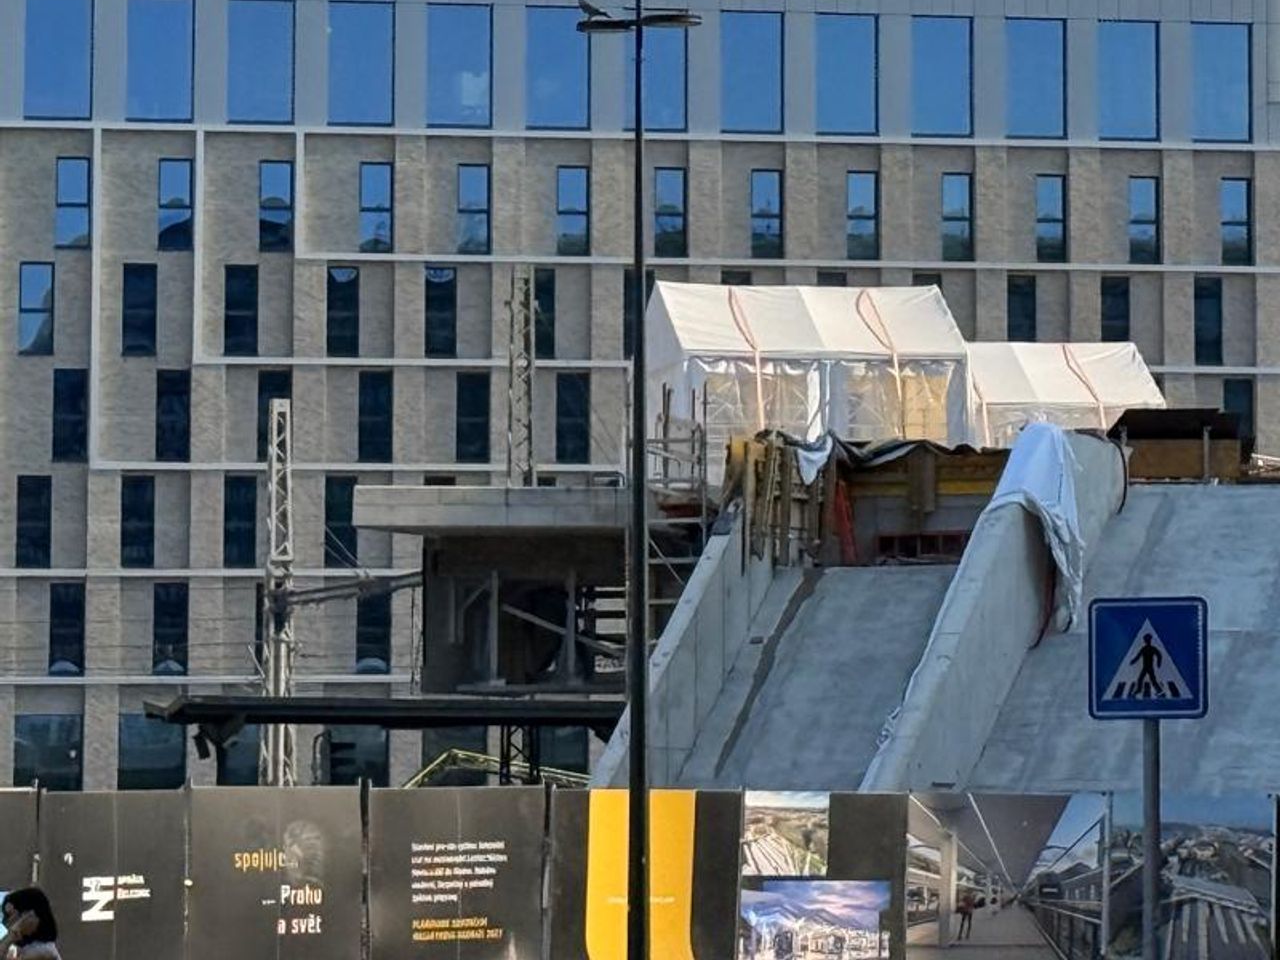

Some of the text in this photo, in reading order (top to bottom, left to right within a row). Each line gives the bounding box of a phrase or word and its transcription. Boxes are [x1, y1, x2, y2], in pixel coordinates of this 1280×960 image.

[281, 884, 323, 905] Prahu
[277, 914, 322, 934] a svět
